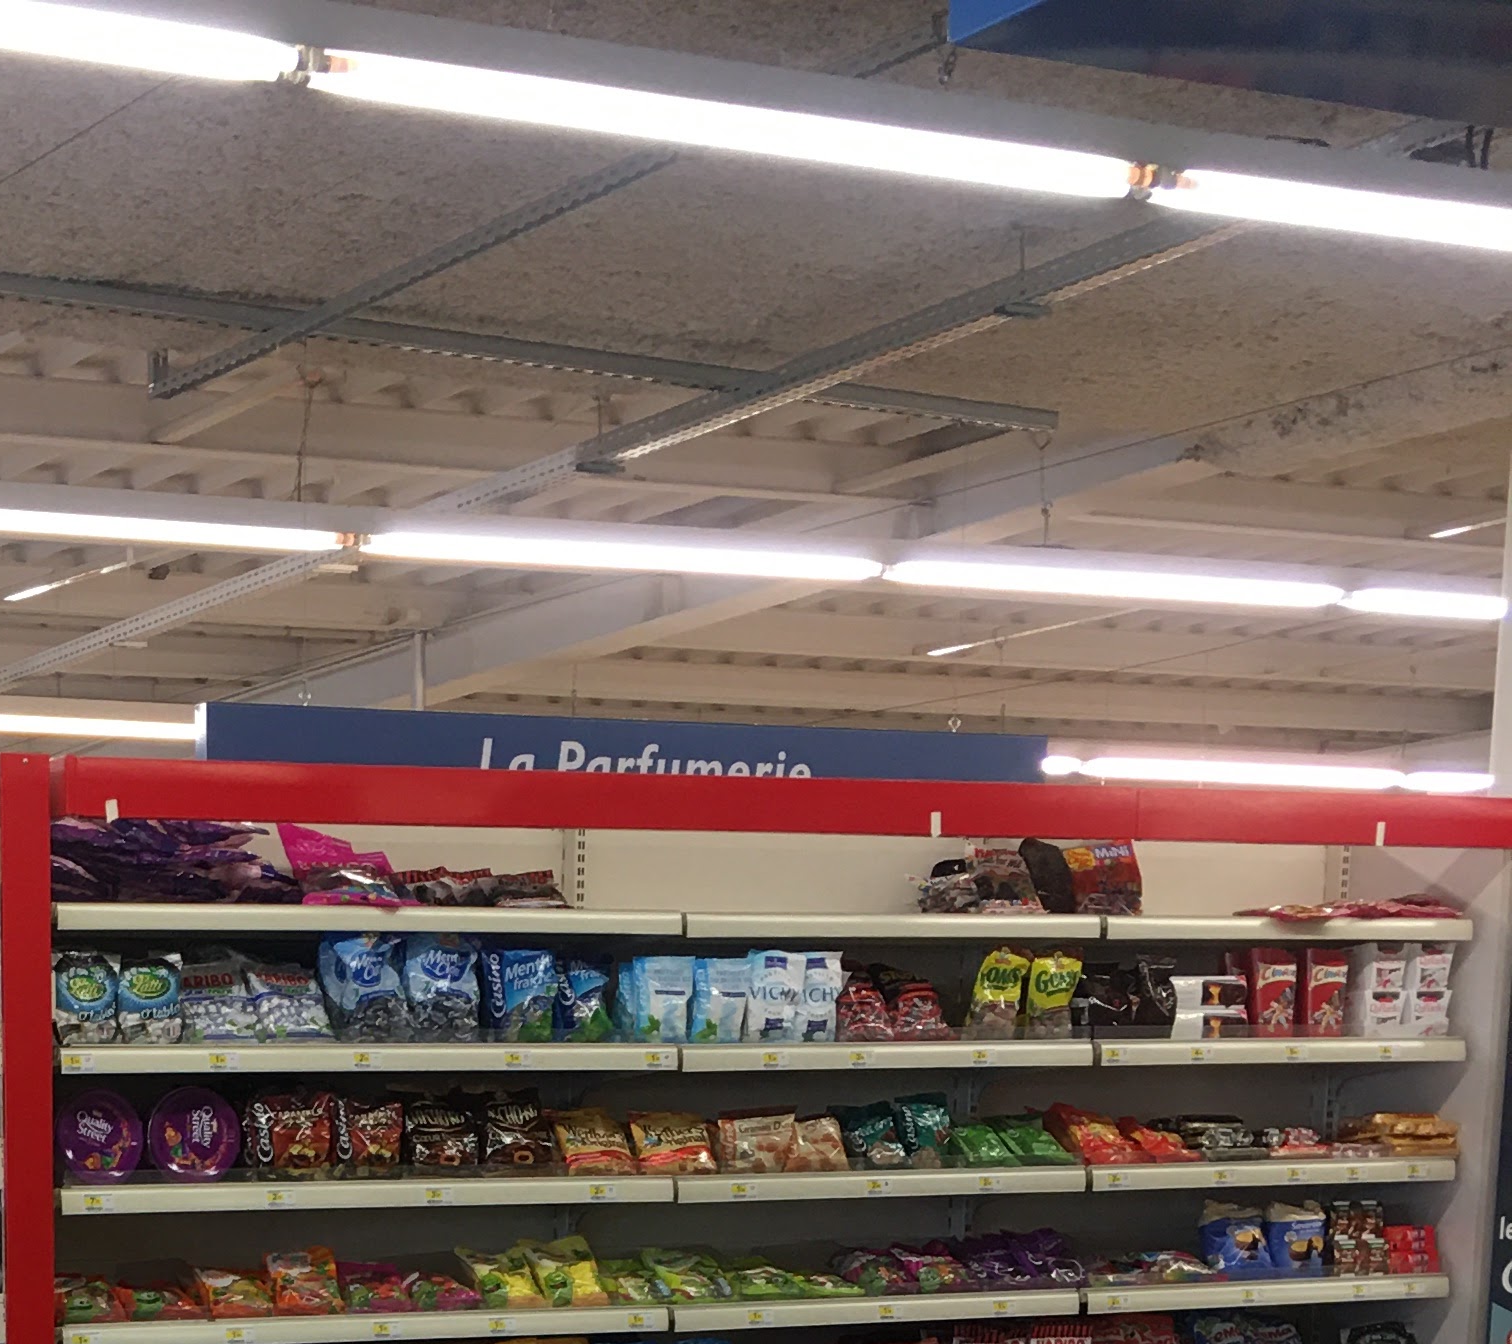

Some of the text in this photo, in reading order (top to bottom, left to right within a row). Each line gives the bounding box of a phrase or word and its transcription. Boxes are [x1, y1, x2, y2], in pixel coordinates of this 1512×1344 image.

[183, 973, 233, 987] ARIBO
[76, 1110, 114, 1133] Quality
[76, 1122, 108, 1144] Street
[191, 1109, 202, 1144] Street
[201, 1105, 214, 1148] Quality
